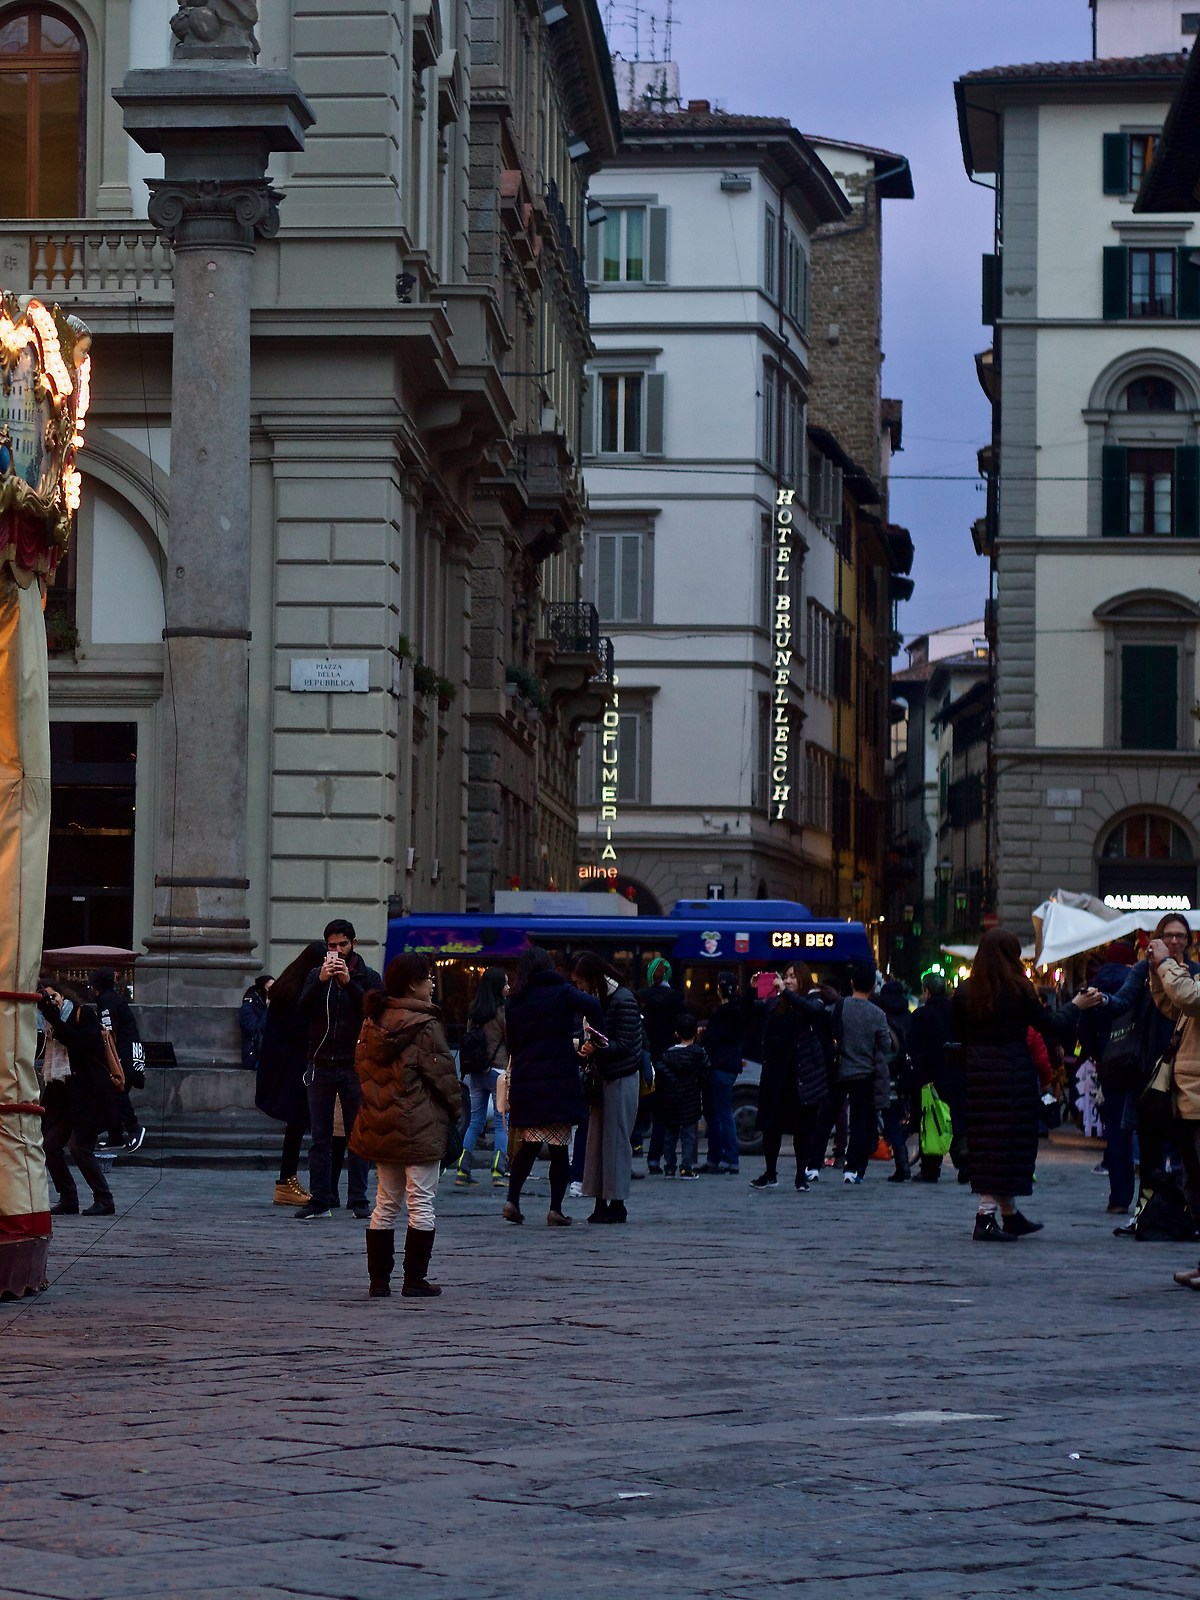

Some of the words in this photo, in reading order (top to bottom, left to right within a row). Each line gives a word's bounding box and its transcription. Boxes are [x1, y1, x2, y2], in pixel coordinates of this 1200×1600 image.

[775, 489, 794, 581] HOTEL
[773, 595, 792, 820] BRUNELLESCHI
[578, 865, 618, 879] aline
